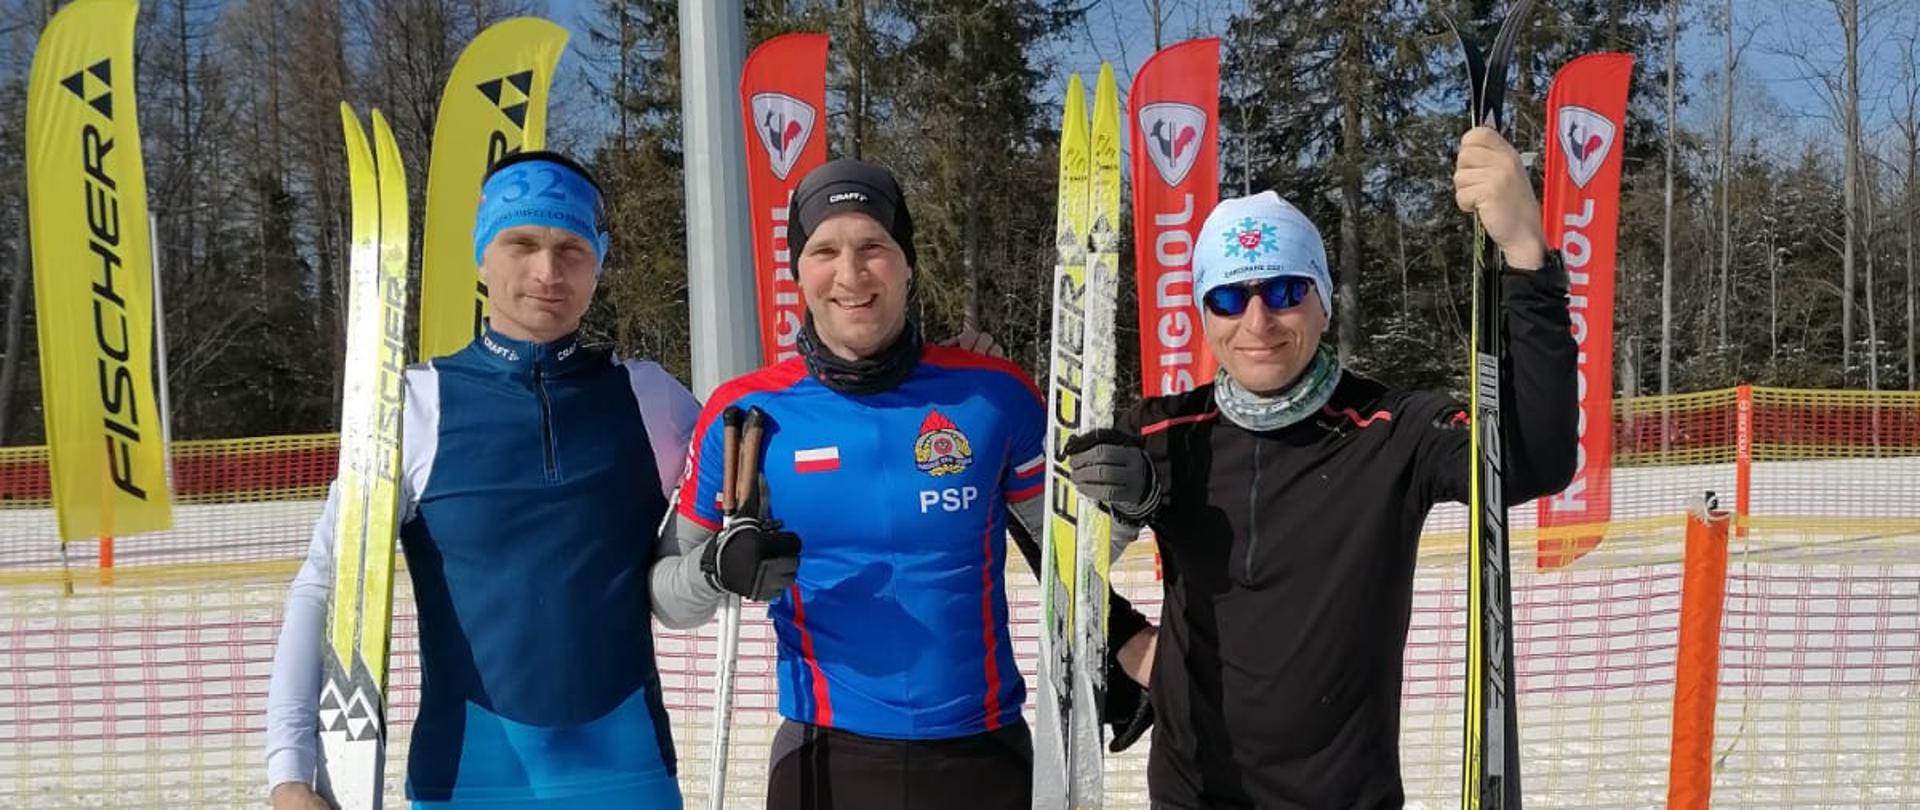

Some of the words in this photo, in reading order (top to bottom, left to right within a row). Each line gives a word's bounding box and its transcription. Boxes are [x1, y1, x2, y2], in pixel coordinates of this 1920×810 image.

[502, 168, 566, 202] 32
[82, 123, 147, 501] FISCHER
[376, 276, 406, 483] FISCHER
[919, 486, 978, 513] PSP
